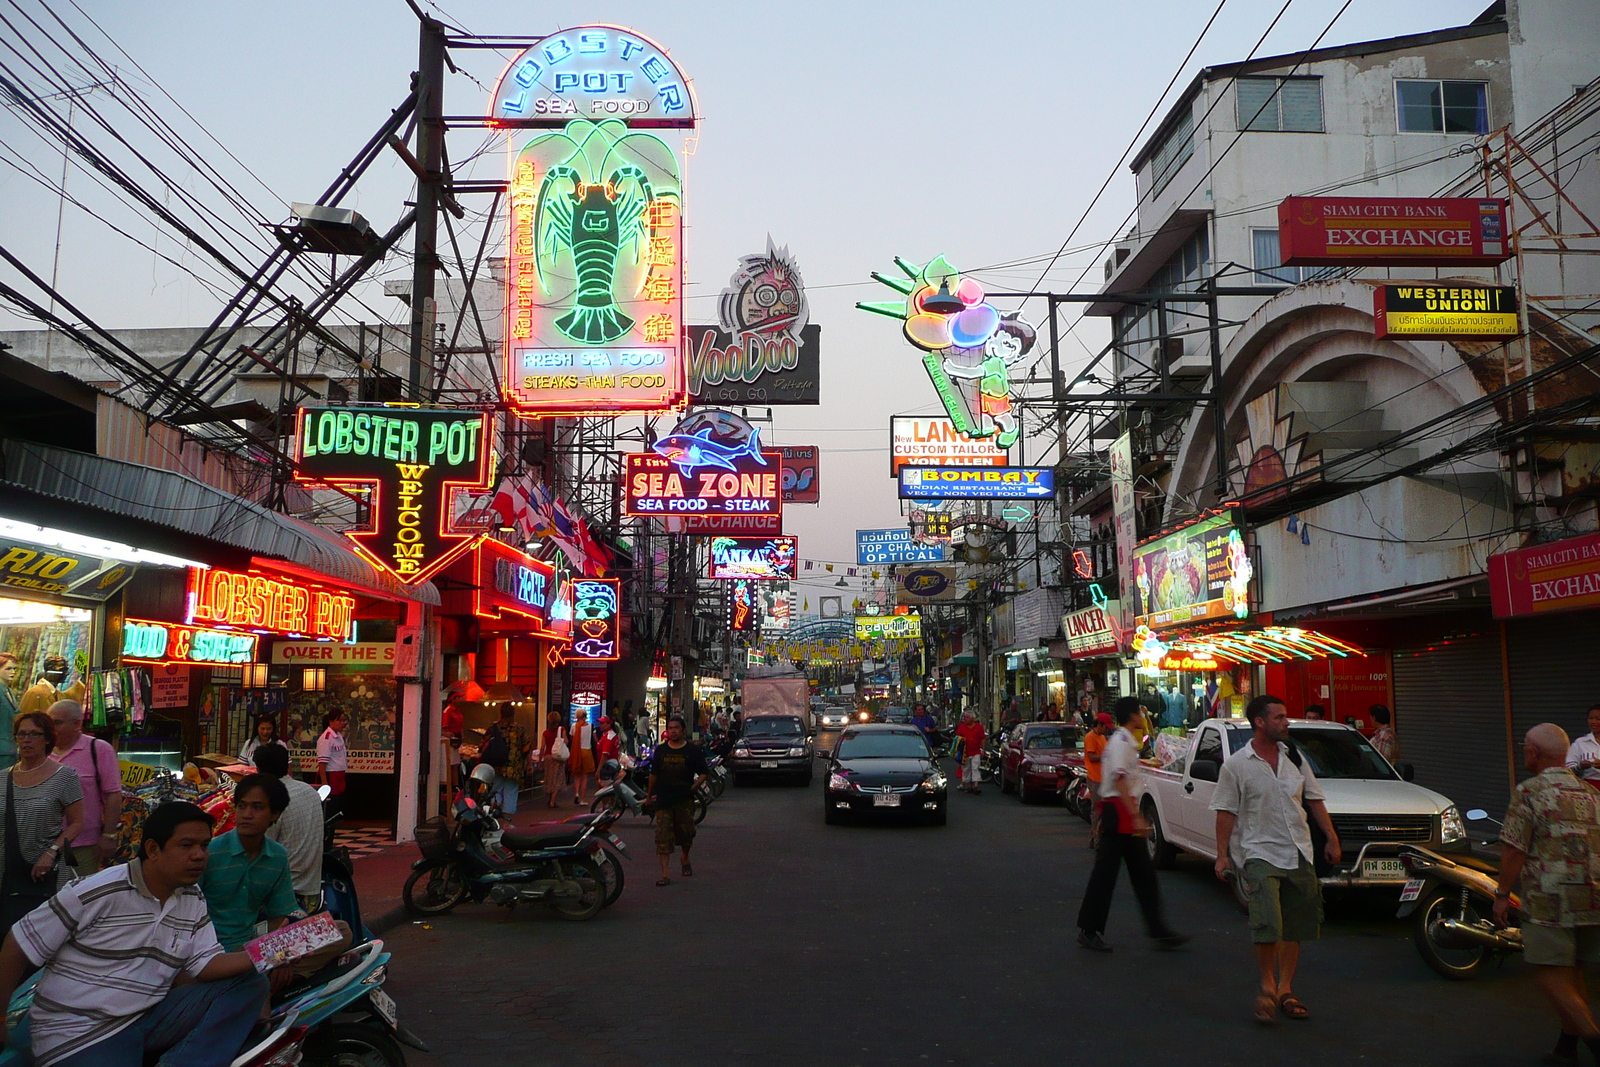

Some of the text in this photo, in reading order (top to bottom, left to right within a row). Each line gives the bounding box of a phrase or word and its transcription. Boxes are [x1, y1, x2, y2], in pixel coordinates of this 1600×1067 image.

[502, 32, 684, 114] LOBSTER
[554, 71, 633, 93] POT
[535, 99, 650, 114] SEA FOOD
[1323, 205, 1447, 217] SIAM CITY BANK
[1326, 229, 1472, 246] EXCHANGE
[1397, 288, 1486, 299] WESTERN
[1426, 300, 1486, 311] UNION
[523, 352, 665, 367] FRESH SEA FOOD
[620, 375, 665, 389] FOOD
[704, 388, 767, 402] A GO GO
[924, 353, 967, 432] ITALIAN GELATO
[303, 411, 482, 465] LOBSTER POT
[895, 421, 1001, 443] New LAN
[895, 445, 1003, 454] CUSTOM TAILORS
[908, 457, 993, 465] VON ALLEN
[922, 471, 1041, 482] BOMBAY
[632, 473, 776, 498] SEA ZONE
[637, 499, 664, 511] SEA
[669, 499, 707, 511] FOOD
[725, 499, 770, 511] STEAK
[393, 463, 430, 574] WELCOME
[688, 516, 777, 528] EXCHANGE
[860, 544, 882, 553] TOP
[1527, 542, 1600, 569] SIAM CITY BA
[0, 547, 79, 579] RIO
[866, 551, 937, 563] OPTICAL
[5, 576, 69, 592] TAILOR
[519, 566, 545, 607] ZONE
[910, 575, 940, 591] Bots
[193, 566, 355, 638] LOBSTER POT
[856, 620, 920, 632] beautiful
[1066, 608, 1108, 637] LANCER
[282, 646, 395, 660] OVER THE S
[1165, 657, 1218, 669] Ice Cream
[1327, 673, 1353, 681] flvours
[575, 681, 605, 691] EXCHANGE
[1351, 683, 1378, 692] flavours
[346, 751, 386, 759] LOBSTER
[125, 765, 143, 784] 150
